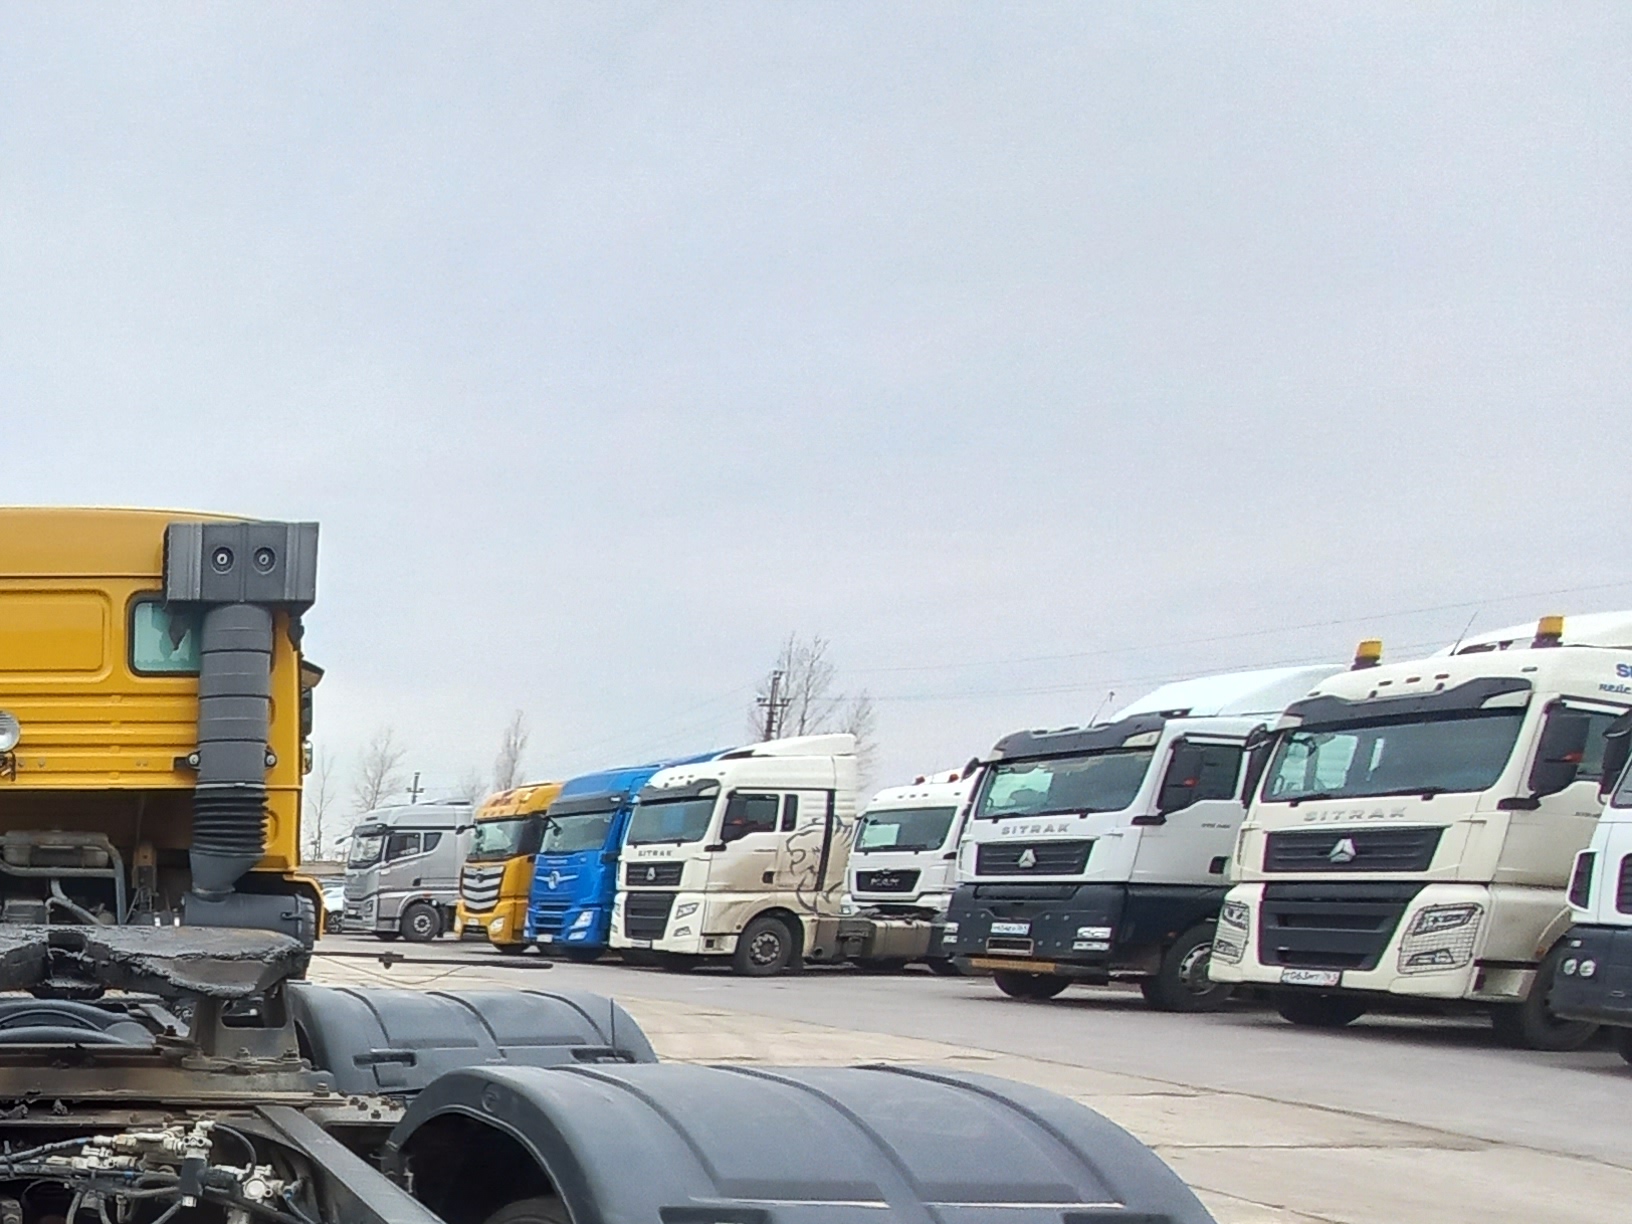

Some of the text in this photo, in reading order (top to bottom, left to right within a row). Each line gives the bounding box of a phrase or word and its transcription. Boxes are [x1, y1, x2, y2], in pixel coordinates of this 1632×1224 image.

[1304, 806, 1408, 822] SITRAK
[1001, 823, 1070, 835] SITRAK
[638, 849, 673, 857] SITRAK
